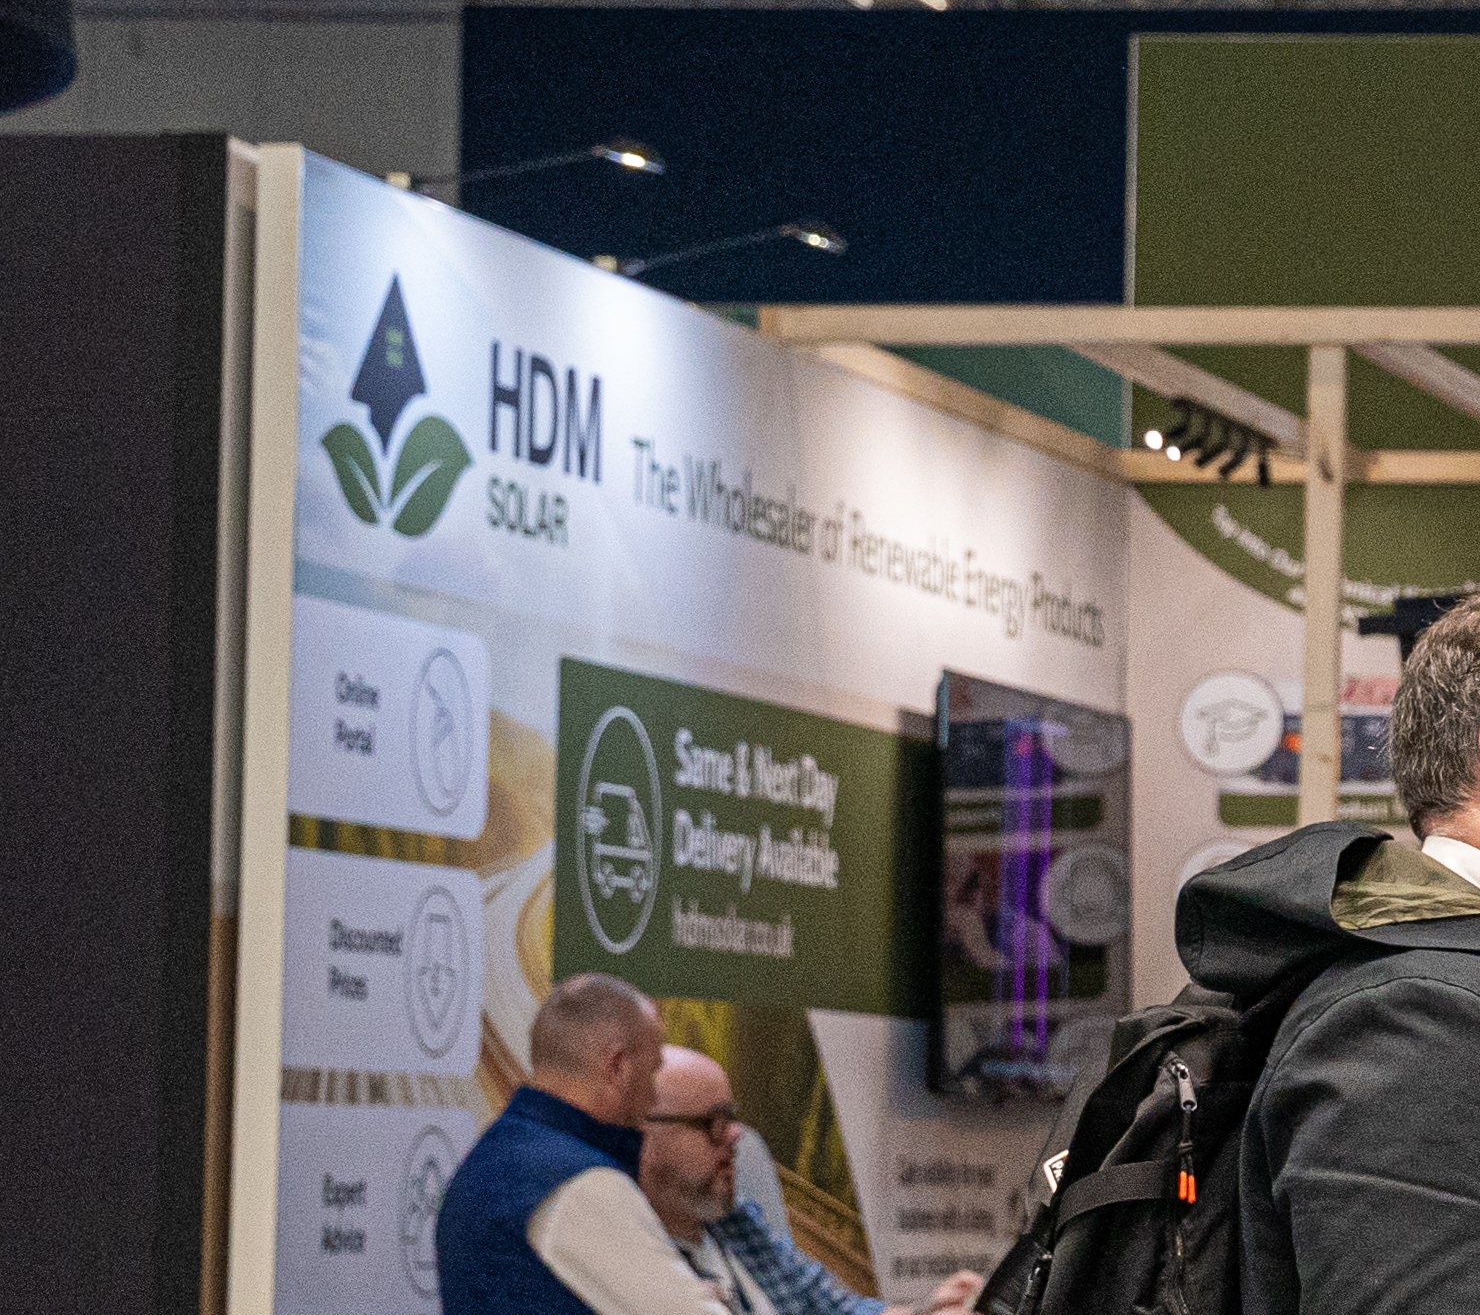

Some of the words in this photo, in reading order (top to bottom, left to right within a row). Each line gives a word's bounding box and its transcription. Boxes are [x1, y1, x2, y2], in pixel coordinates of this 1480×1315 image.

[488, 338, 604, 484] HDM
[488, 474, 569, 546] SOLAR
[631, 436, 679, 516] The
[684, 454, 816, 556] Wholesaler
[819, 499, 846, 564] of
[850, 509, 959, 602] Renewable
[962, 547, 1029, 639] Energy
[1029, 570, 1105, 647] Products
[674, 727, 733, 794] Same
[735, 740, 750, 799] &
[753, 744, 800, 807] Next
[801, 752, 839, 831] Day
[673, 808, 756, 893] Delivery
[758, 823, 840, 890] Available
